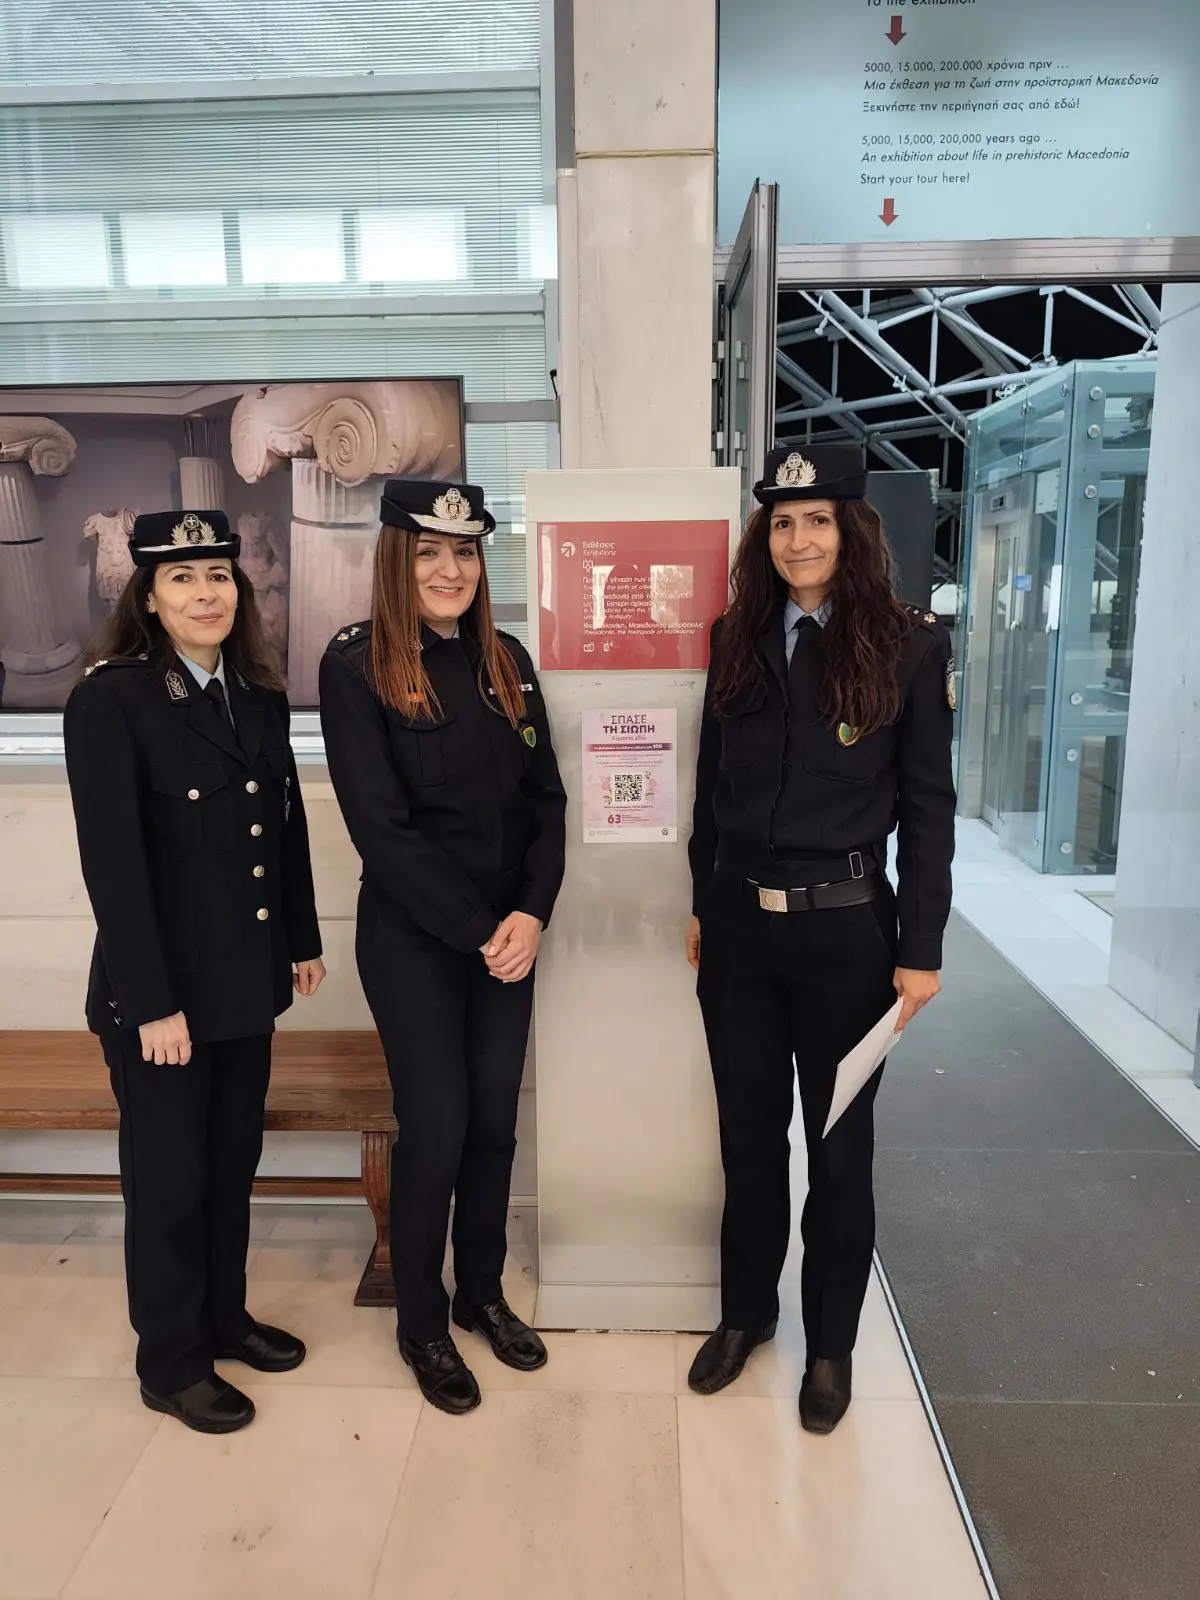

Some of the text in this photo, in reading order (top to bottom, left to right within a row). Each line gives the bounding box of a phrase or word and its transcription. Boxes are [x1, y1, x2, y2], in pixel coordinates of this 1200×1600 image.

[864, 62, 893, 73] 5000,
[898, 61, 936, 72] 15.000,
[940, 60, 983, 71] 200.000
[987, 59, 1025, 72] χρόνια
[1029, 61, 1052, 71] πριν
[864, 73, 1159, 92] Μια έκθεση για τη ζωή στην προϊστορική Μακεδονία
[863, 101, 916, 112] Ξεκινήστε
[920, 103, 937, 111] την
[1003, 102, 1024, 111] σας
[1029, 99, 1050, 109] από
[1054, 98, 1080, 109] εδώ!
[861, 135, 893, 146] 5,000,
[898, 134, 936, 145] 15,000,
[940, 134, 982, 145] 200,000
[986, 134, 1015, 145] years
[1019, 134, 1041, 144] ago
[861, 147, 1130, 162] An exhibition about life in prehistoric Macedonia
[860, 172, 970, 186] Start your tour here!
[611, 714, 647, 724] ΣΠΑΣΕ
[603, 724, 655, 734] ΤΗ ΣΙΩΠΗ
[607, 814, 622, 824] 63
